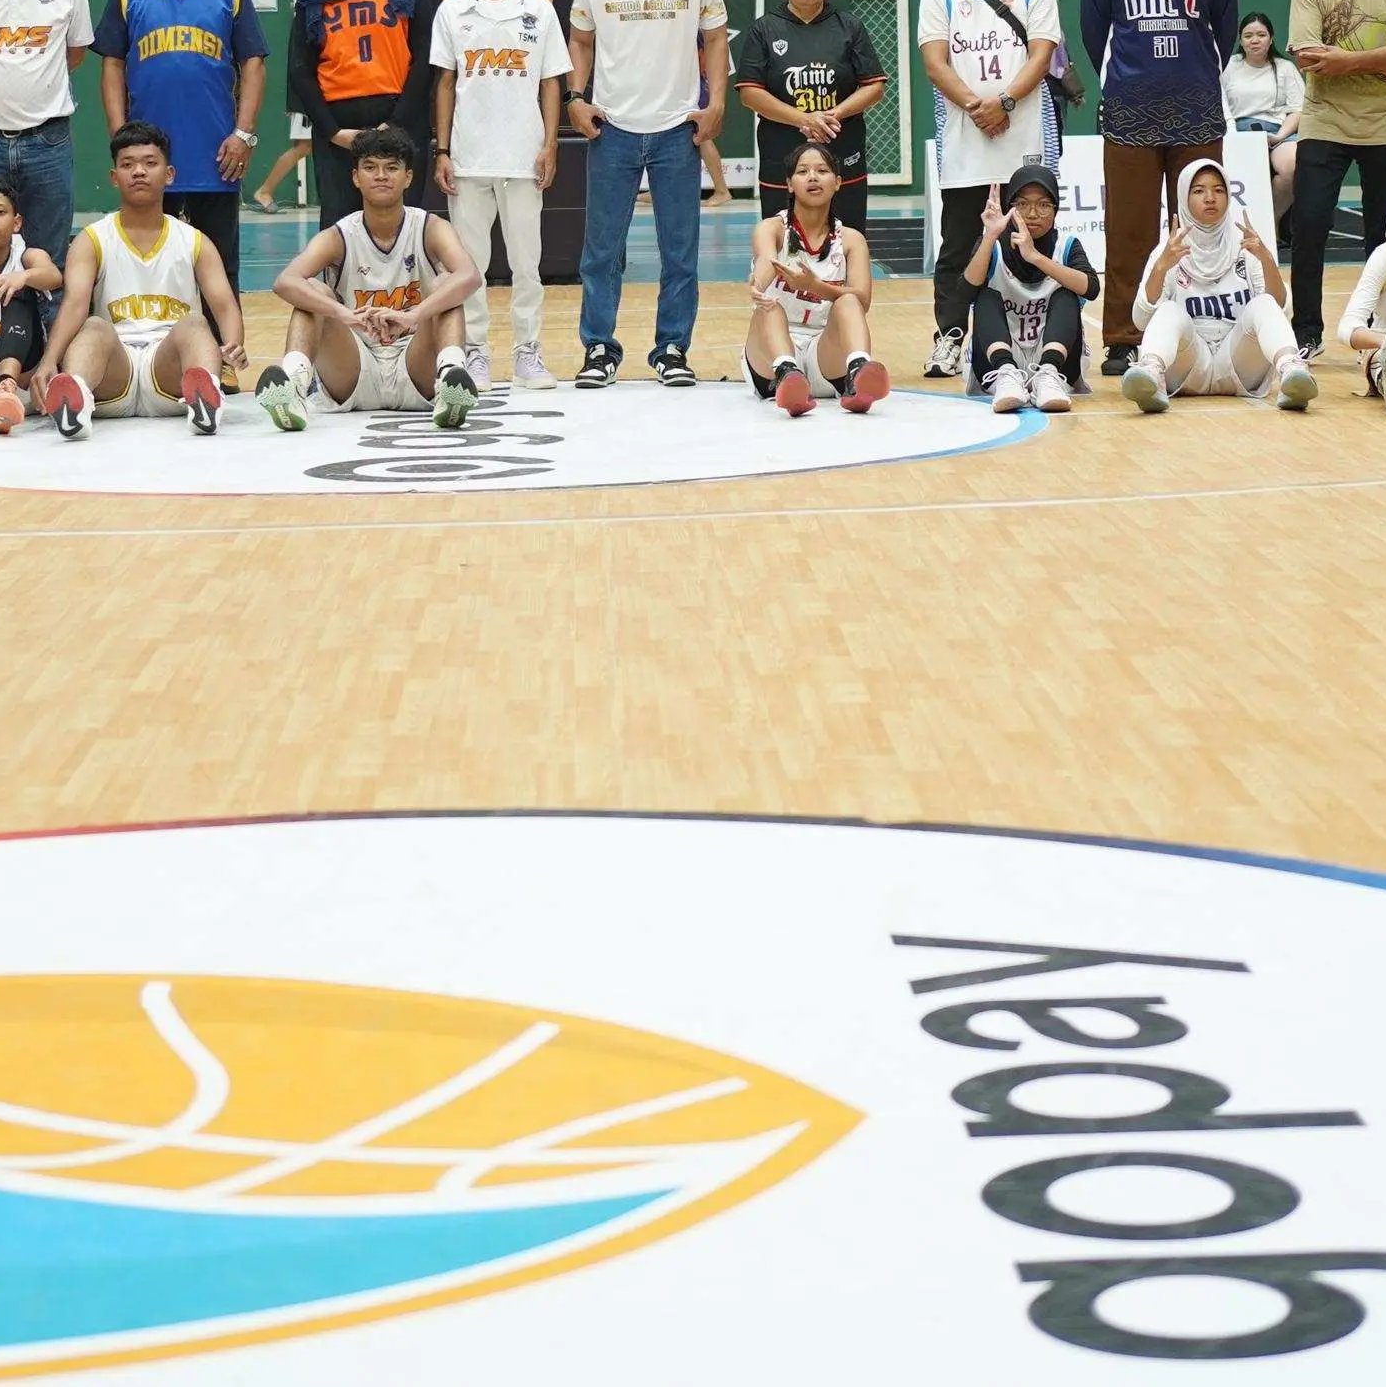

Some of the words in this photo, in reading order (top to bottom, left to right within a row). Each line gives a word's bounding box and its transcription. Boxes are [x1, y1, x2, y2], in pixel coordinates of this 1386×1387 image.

[137, 25, 224, 62] DIMENSI
[463, 48, 531, 71] YMS
[979, 54, 1002, 82] 14
[783, 64, 836, 96] Time
[817, 85, 828, 97] to
[793, 87, 837, 113] Riot
[353, 280, 422, 311] YMS
[1018, 316, 1041, 343] 13
